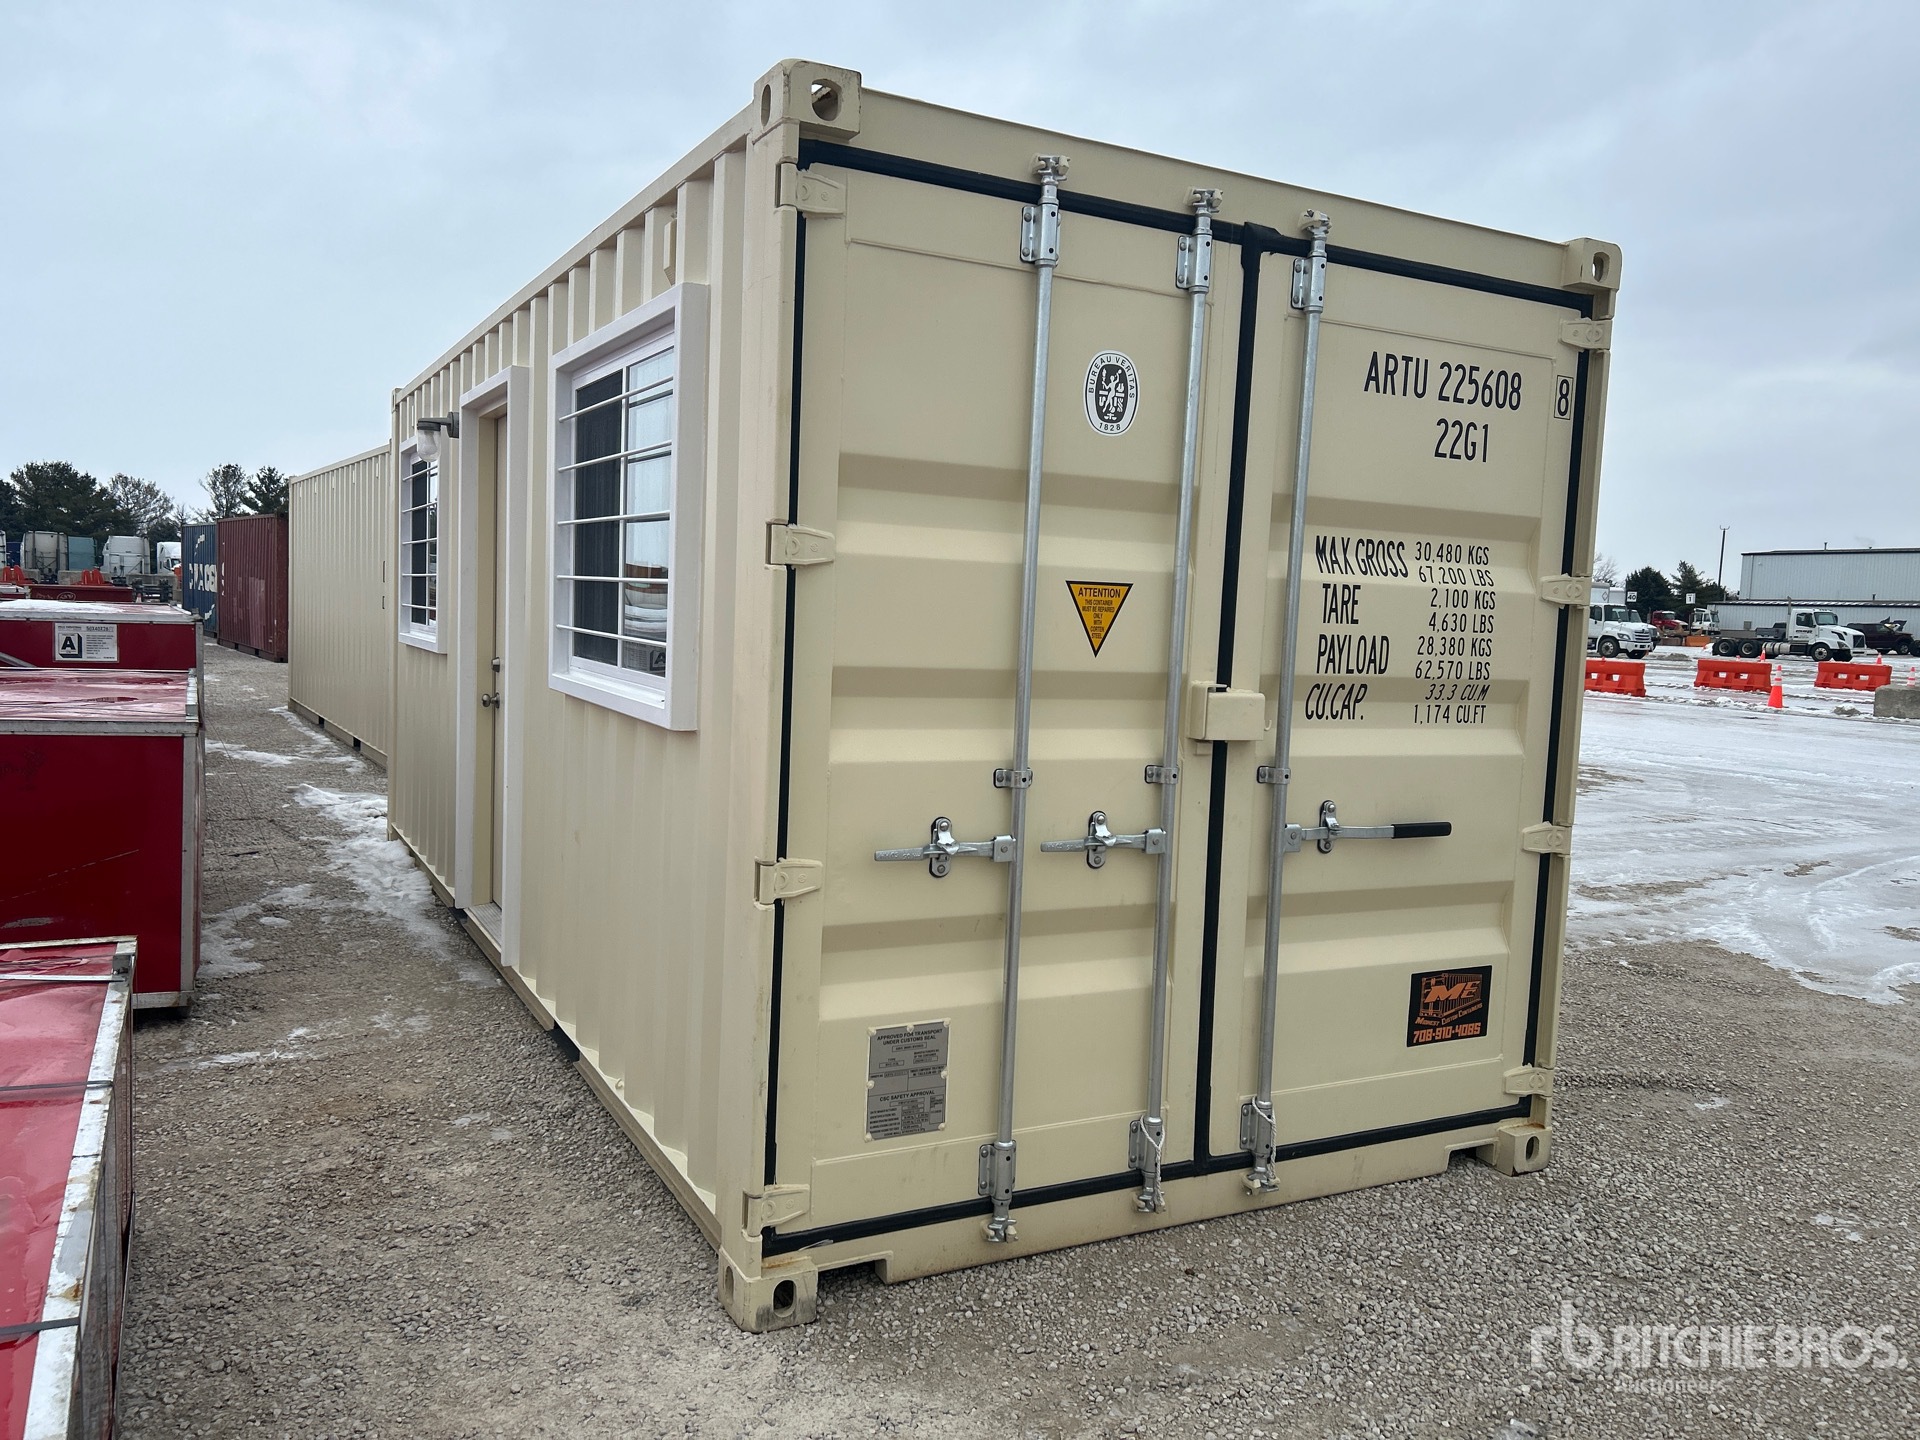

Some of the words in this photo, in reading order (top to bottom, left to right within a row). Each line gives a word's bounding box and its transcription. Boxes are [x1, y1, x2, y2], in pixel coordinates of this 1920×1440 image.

[1088, 355, 1112, 393] BUREAU
[1115, 356, 1135, 399] VERITAS
[1363, 351, 1429, 399] ARTU
[1437, 361, 1522, 411] 225608
[1556, 378, 1569, 417] 8
[1099, 422, 1121, 431] 1828
[1434, 418, 1489, 463] 22G1
[1315, 535, 1355, 575] MAX
[1355, 538, 1409, 578] GROSS
[1414, 541, 1462, 564] 30,480
[1467, 545, 1489, 566] KGS
[1469, 568, 1494, 587] LBS
[1078, 587, 1121, 598] ATTENTION
[1430, 587, 1468, 609] 2,100
[1474, 590, 1496, 610] KGS
[1322, 583, 1361, 625] TARE
[1428, 611, 1467, 633] 4,630
[1472, 614, 1494, 634] LBS
[61, 636, 76, 650] A
[1417, 635, 1465, 657] 28,380
[1470, 637, 1492, 657] KGS
[1316, 634, 1390, 675] PAYLOAD
[1468, 661, 1491, 680] LBS
[1425, 683, 1457, 701] 33.3
[1460, 684, 1490, 701] CU.M
[1456, 704, 1487, 724] CU.FT
[877, 1033, 904, 1041] APPROVED
[914, 1028, 943, 1036] TRANSPORT
